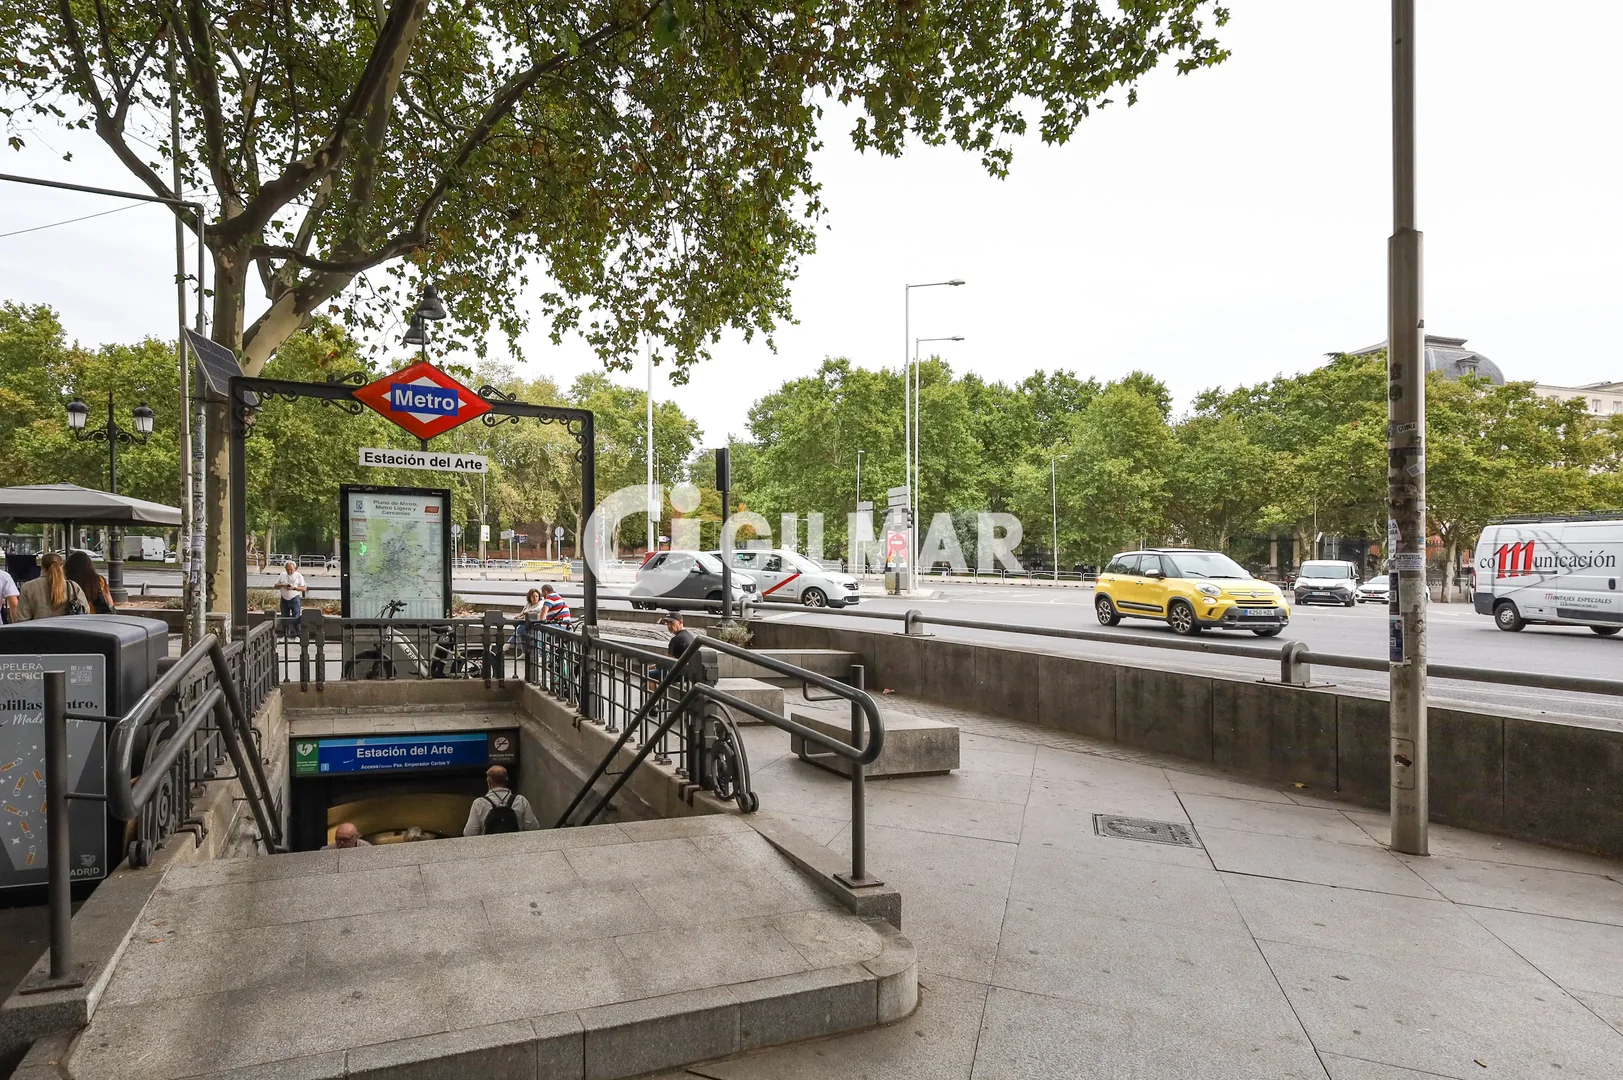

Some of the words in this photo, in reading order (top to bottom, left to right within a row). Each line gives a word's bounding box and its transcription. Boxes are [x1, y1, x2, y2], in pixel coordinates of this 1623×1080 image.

[395, 389, 455, 411] Metro
[364, 451, 425, 466] Estación
[429, 456, 451, 467] del
[454, 458, 482, 470] Arte
[1577, 596, 1612, 604] ESPECIALES
[7, 672, 44, 680] CENICE
[66, 699, 98, 710] ntro,
[356, 746, 407, 759] Estación
[410, 746, 427, 756] del
[430, 745, 454, 755] Arte
[69, 867, 100, 877] ADRID
